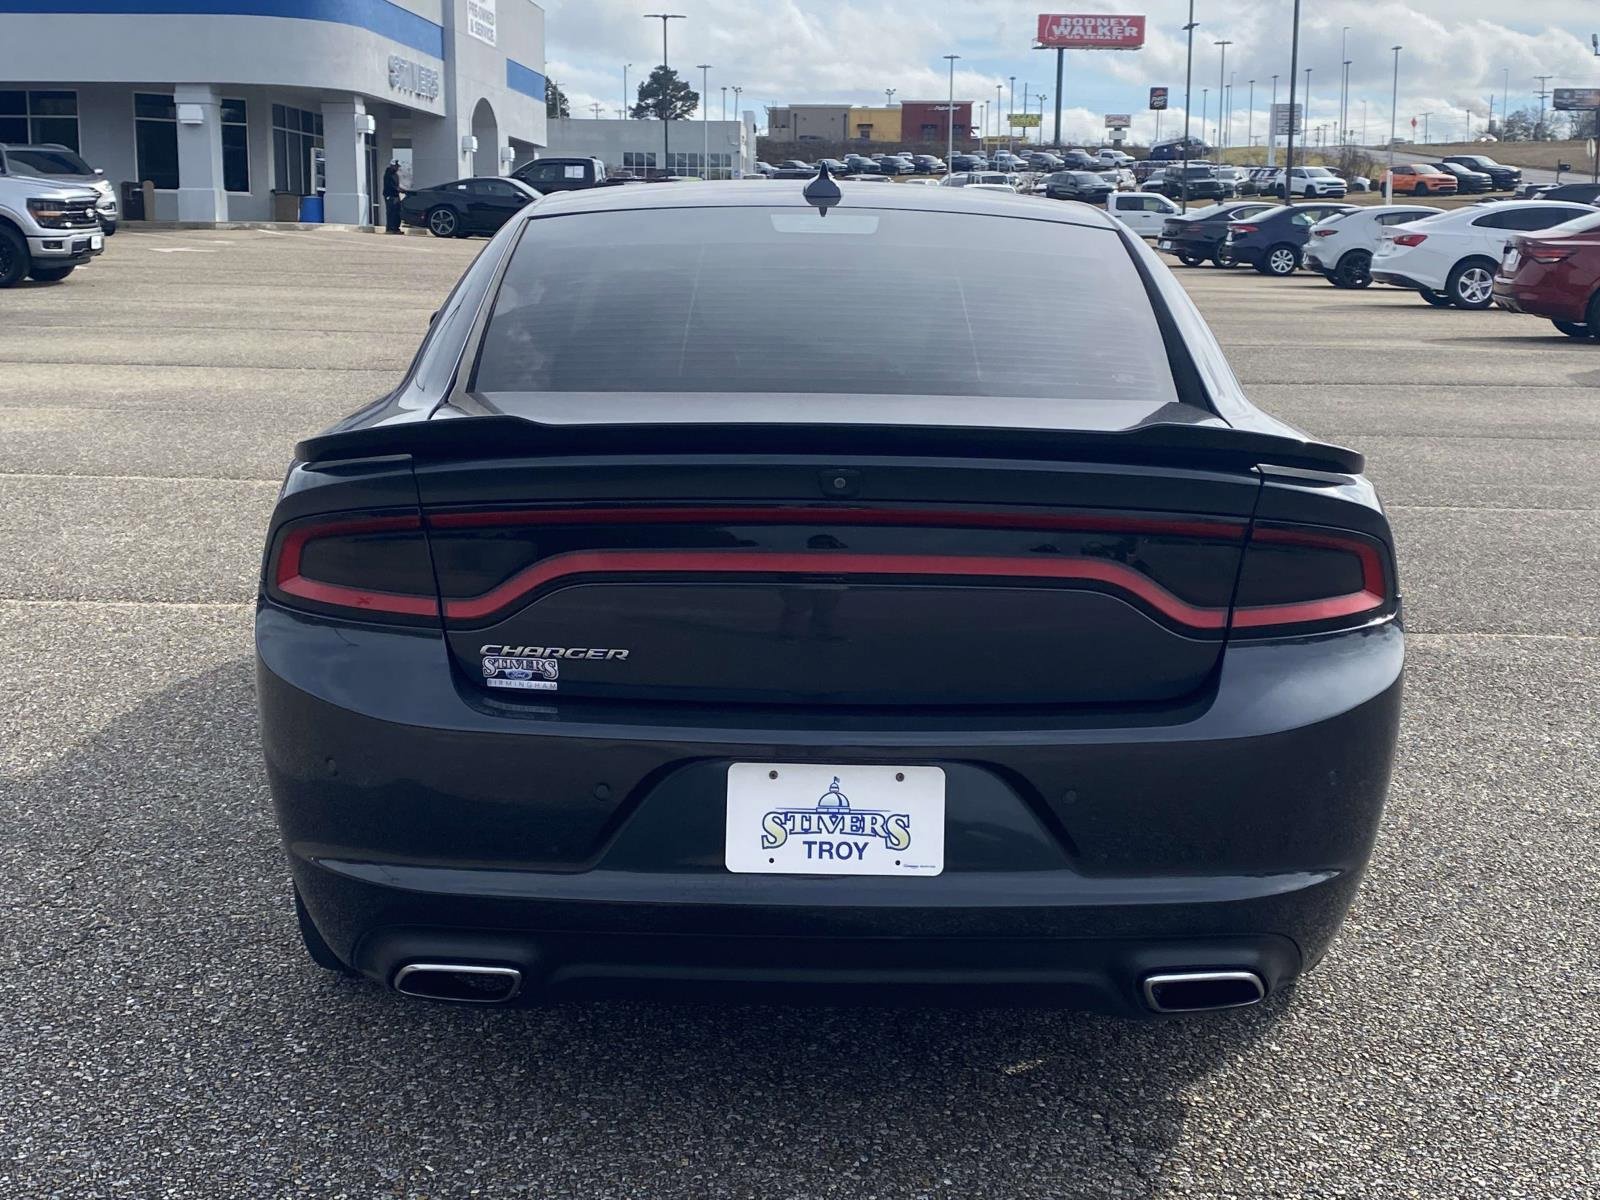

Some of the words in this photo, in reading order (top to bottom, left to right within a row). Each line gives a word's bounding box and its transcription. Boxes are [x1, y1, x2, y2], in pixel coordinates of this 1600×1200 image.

[1060, 17, 1130, 27] RODNEY
[1052, 25, 1138, 37] WALKER
[480, 644, 630, 661] CHARGER
[482, 657, 559, 679] STIVERS
[487, 679, 557, 689] BIRMINGHAM
[761, 811, 911, 851] STIVERS
[803, 841, 869, 860] TROY
